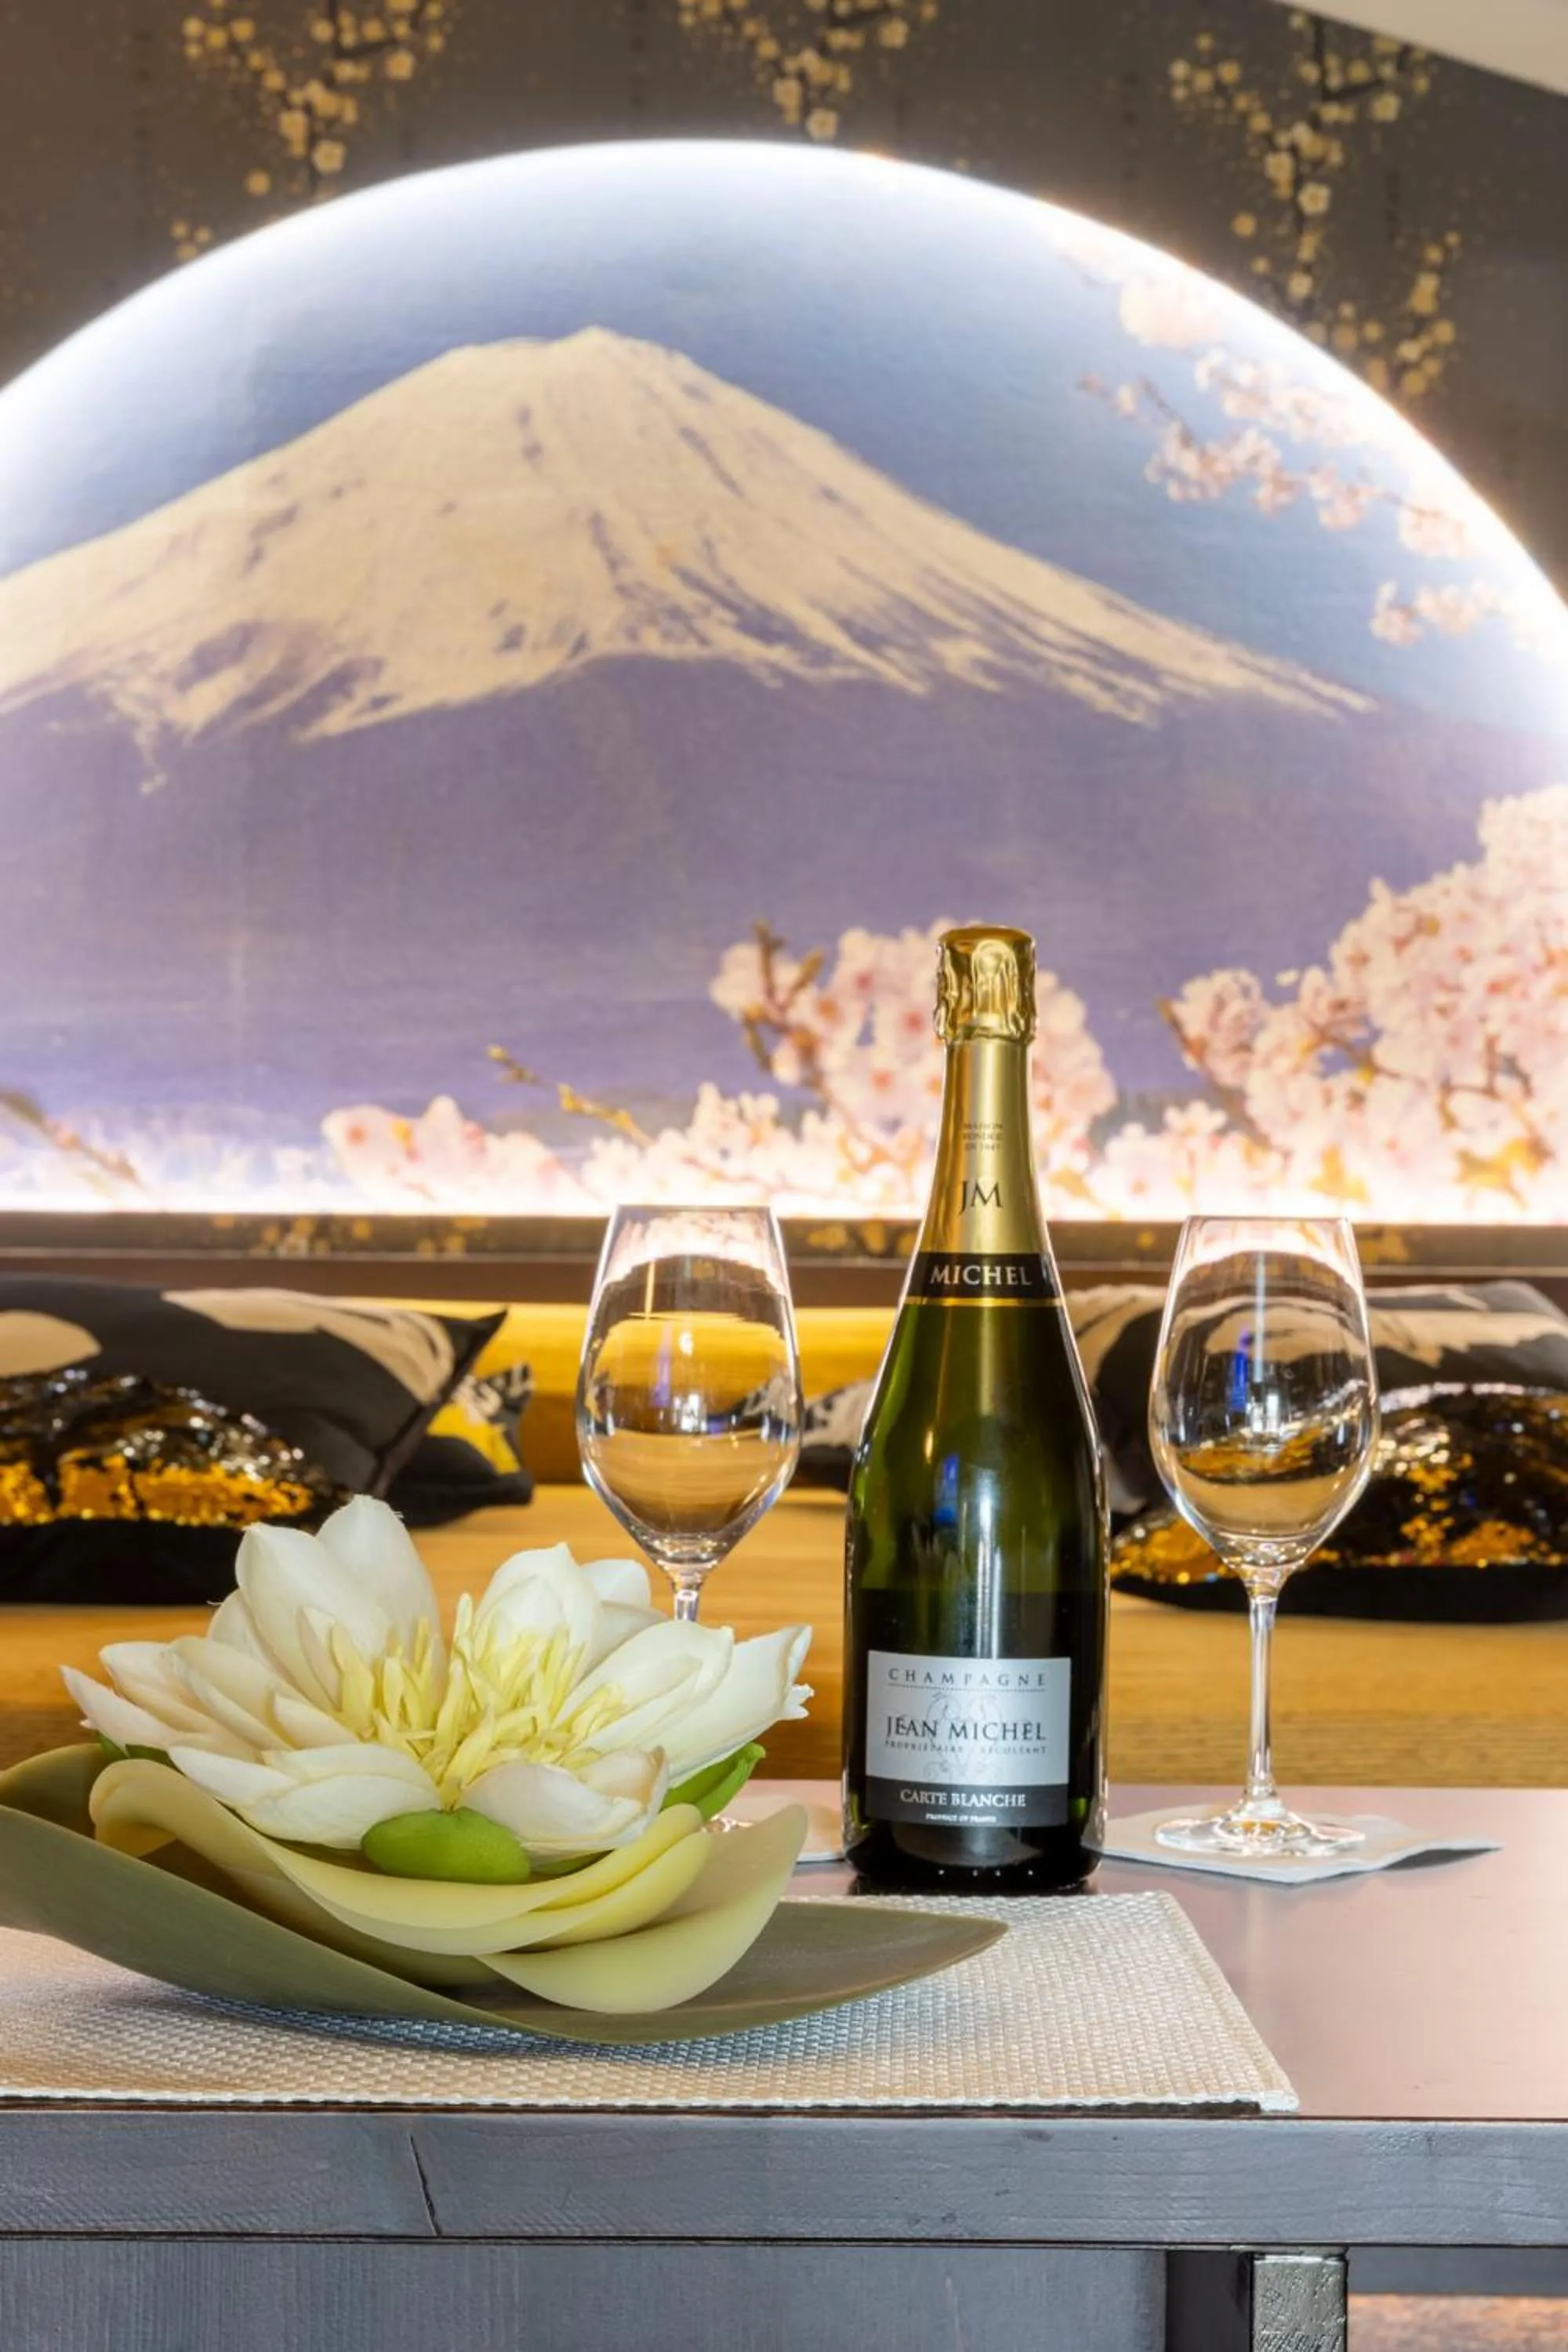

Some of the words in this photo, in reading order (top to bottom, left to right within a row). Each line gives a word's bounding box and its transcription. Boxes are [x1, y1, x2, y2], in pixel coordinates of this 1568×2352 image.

[959, 1180, 1004, 1214] JM
[930, 1265, 1032, 1286] MICHEL
[888, 1668, 1046, 1686] CHAMPAGNE
[887, 1716, 938, 1738] JEAN
[949, 1722, 1047, 1740] MICHEL
[900, 1788, 947, 1806] CARTE
[950, 1792, 1026, 1807] BLANCHE
